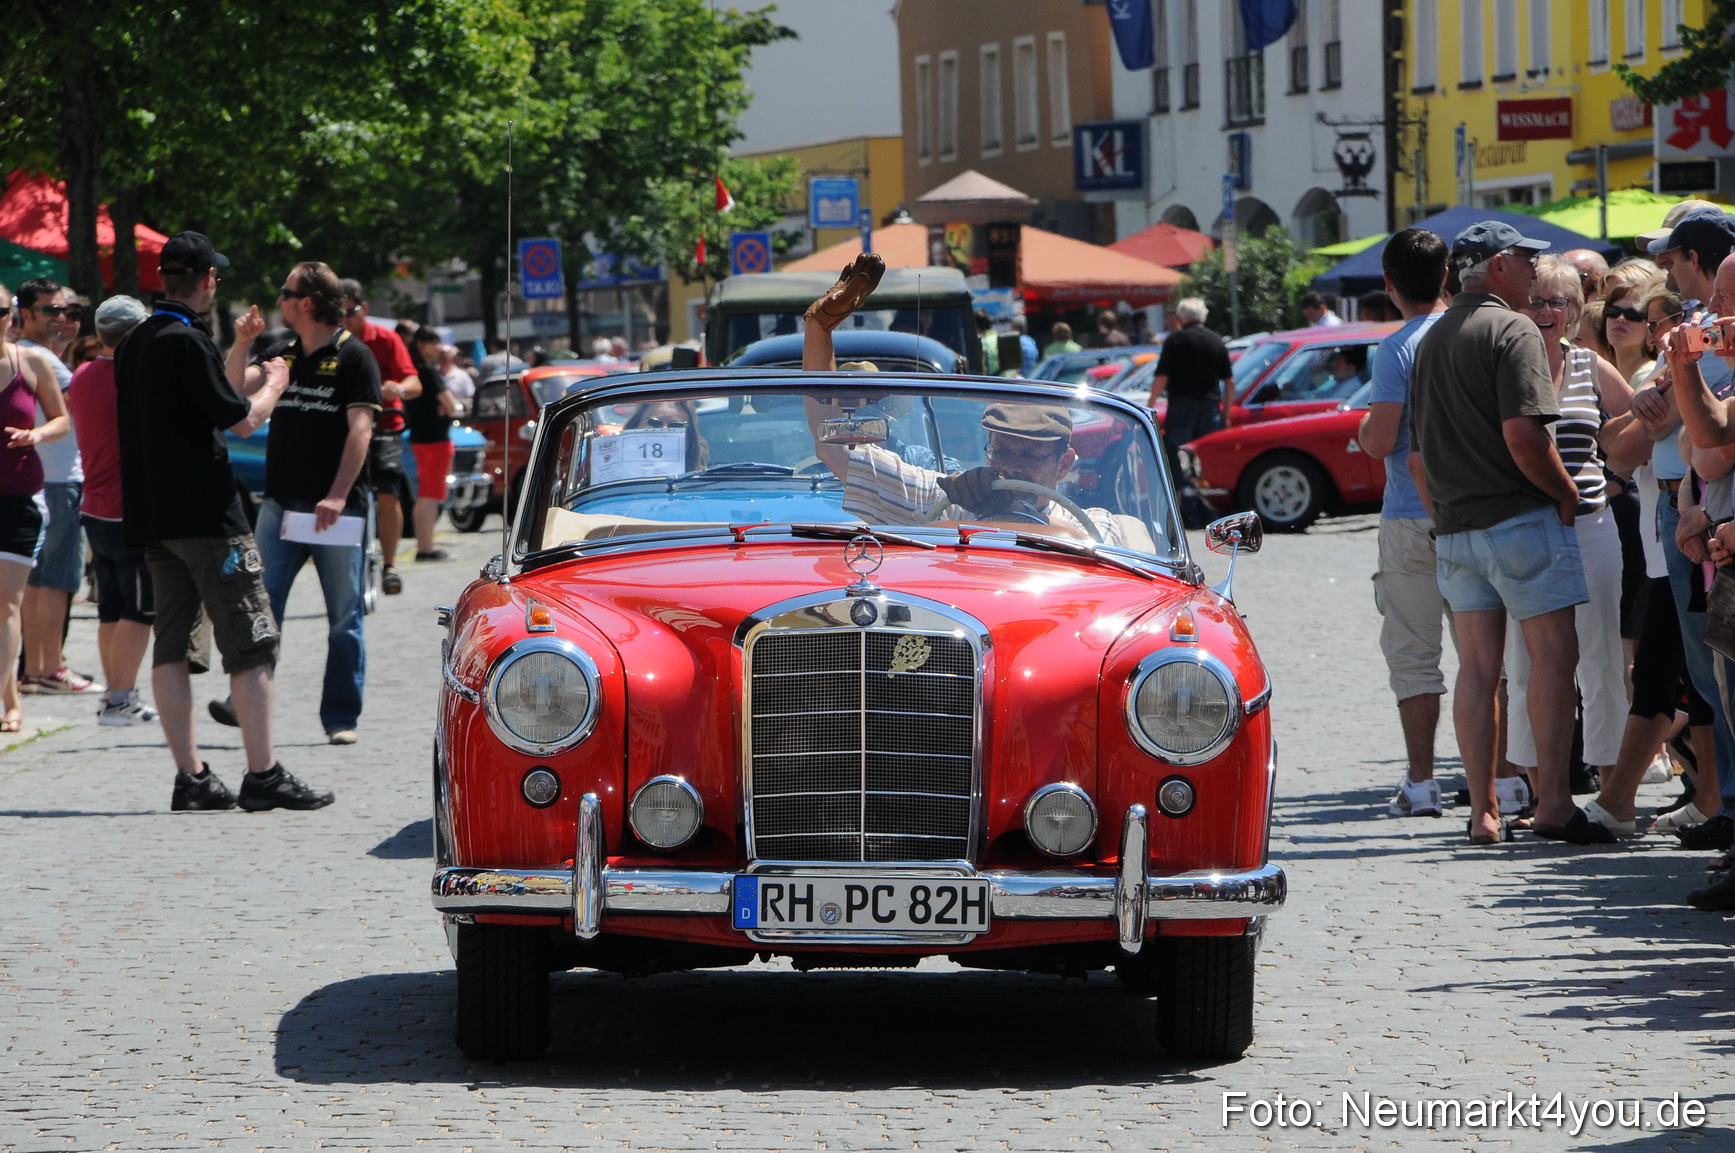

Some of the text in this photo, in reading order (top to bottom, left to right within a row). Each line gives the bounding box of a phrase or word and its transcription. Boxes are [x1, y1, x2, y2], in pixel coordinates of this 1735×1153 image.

[1501, 112, 1570, 128] WISSMACH
[1081, 130, 1135, 177] KL
[525, 281, 561, 296] TAXI
[638, 442, 664, 459] 18
[760, 883, 987, 926] RH PC 82H
[741, 908, 751, 920] D
